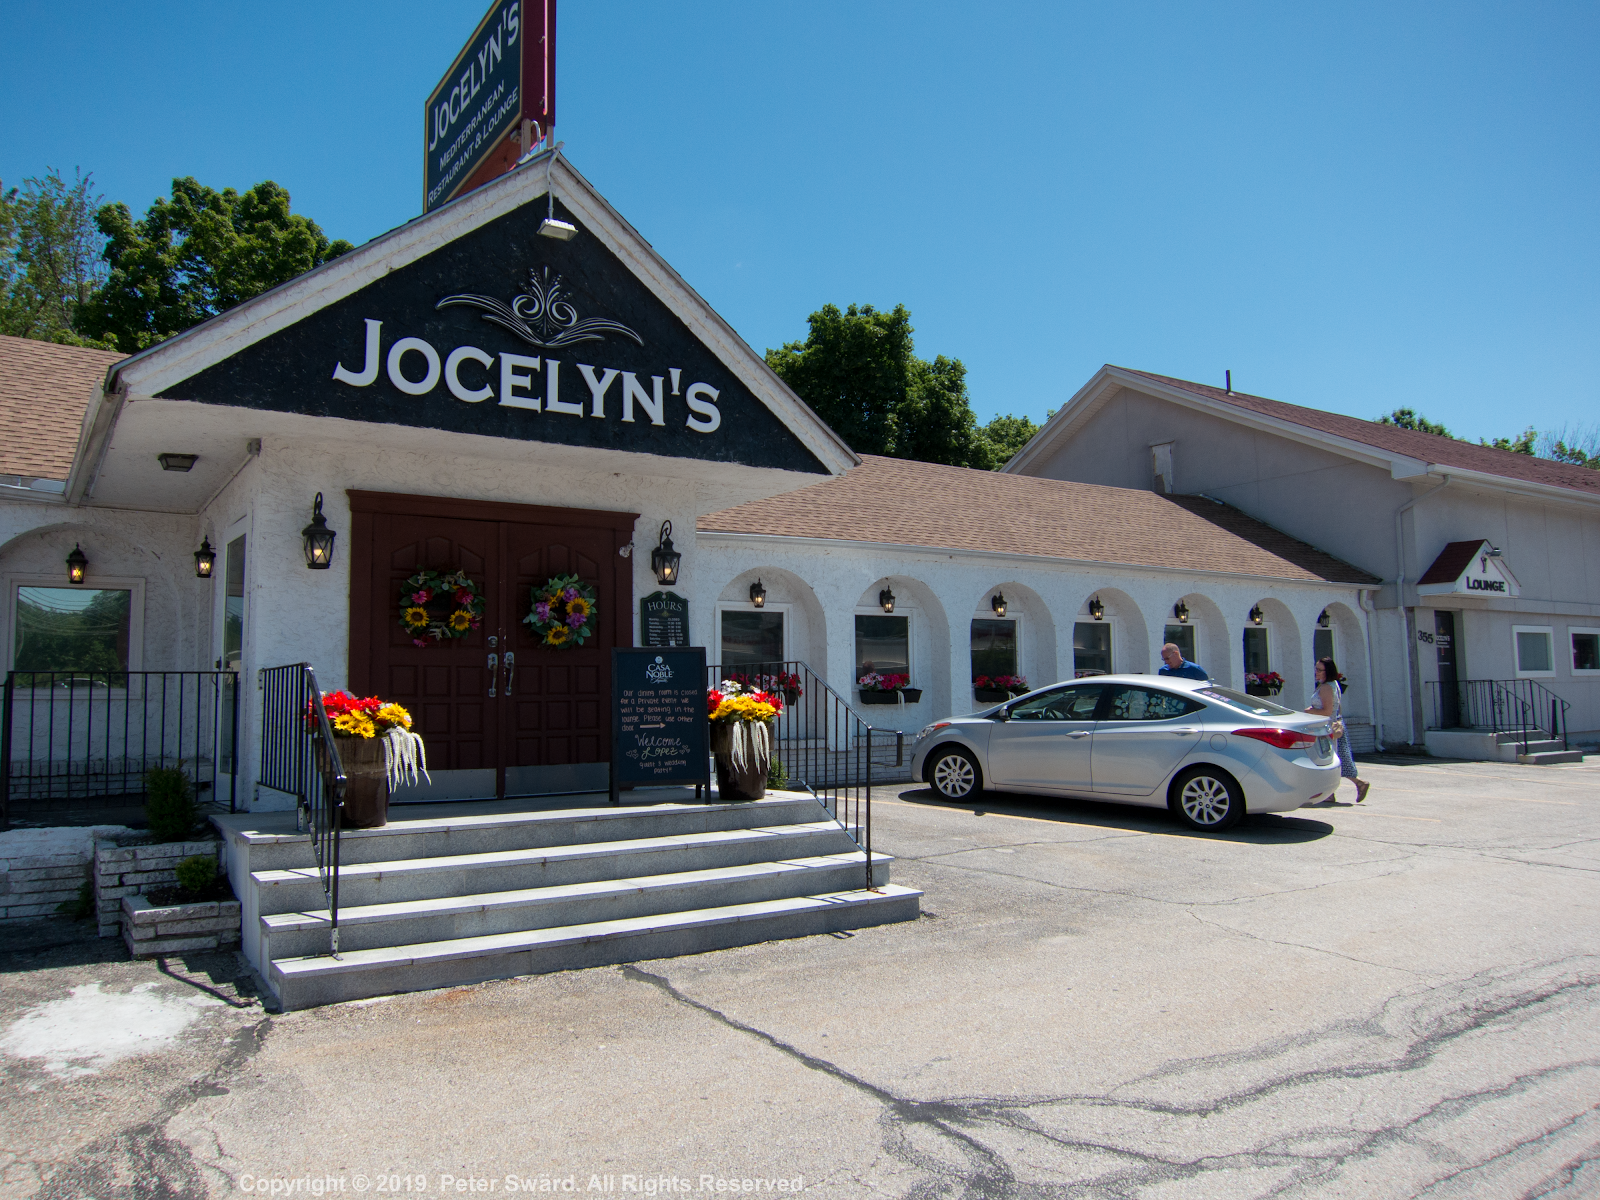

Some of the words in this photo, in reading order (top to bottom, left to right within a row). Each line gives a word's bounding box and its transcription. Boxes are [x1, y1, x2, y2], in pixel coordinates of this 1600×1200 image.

[429, 2, 519, 152] JOCELYN'S
[439, 80, 505, 171] MEDITERRANEAN
[428, 141, 475, 207] RESTAURANT
[475, 132, 482, 149] &
[483, 86, 519, 140] LOUNGE
[332, 318, 722, 433] JOCELYN'S
[1466, 576, 1505, 592] LOUNGE
[647, 600, 683, 611] HOURS
[1417, 630, 1434, 644] 355
[647, 663, 671, 672] CASA
[645, 670, 673, 679] NOBLE
[623, 689, 634, 697] Our
[637, 689, 655, 697] dining
[620, 697, 629, 705] for
[643, 714, 662, 722] Please
[634, 732, 682, 747] Welcome
[641, 747, 678, 760] Lopez
